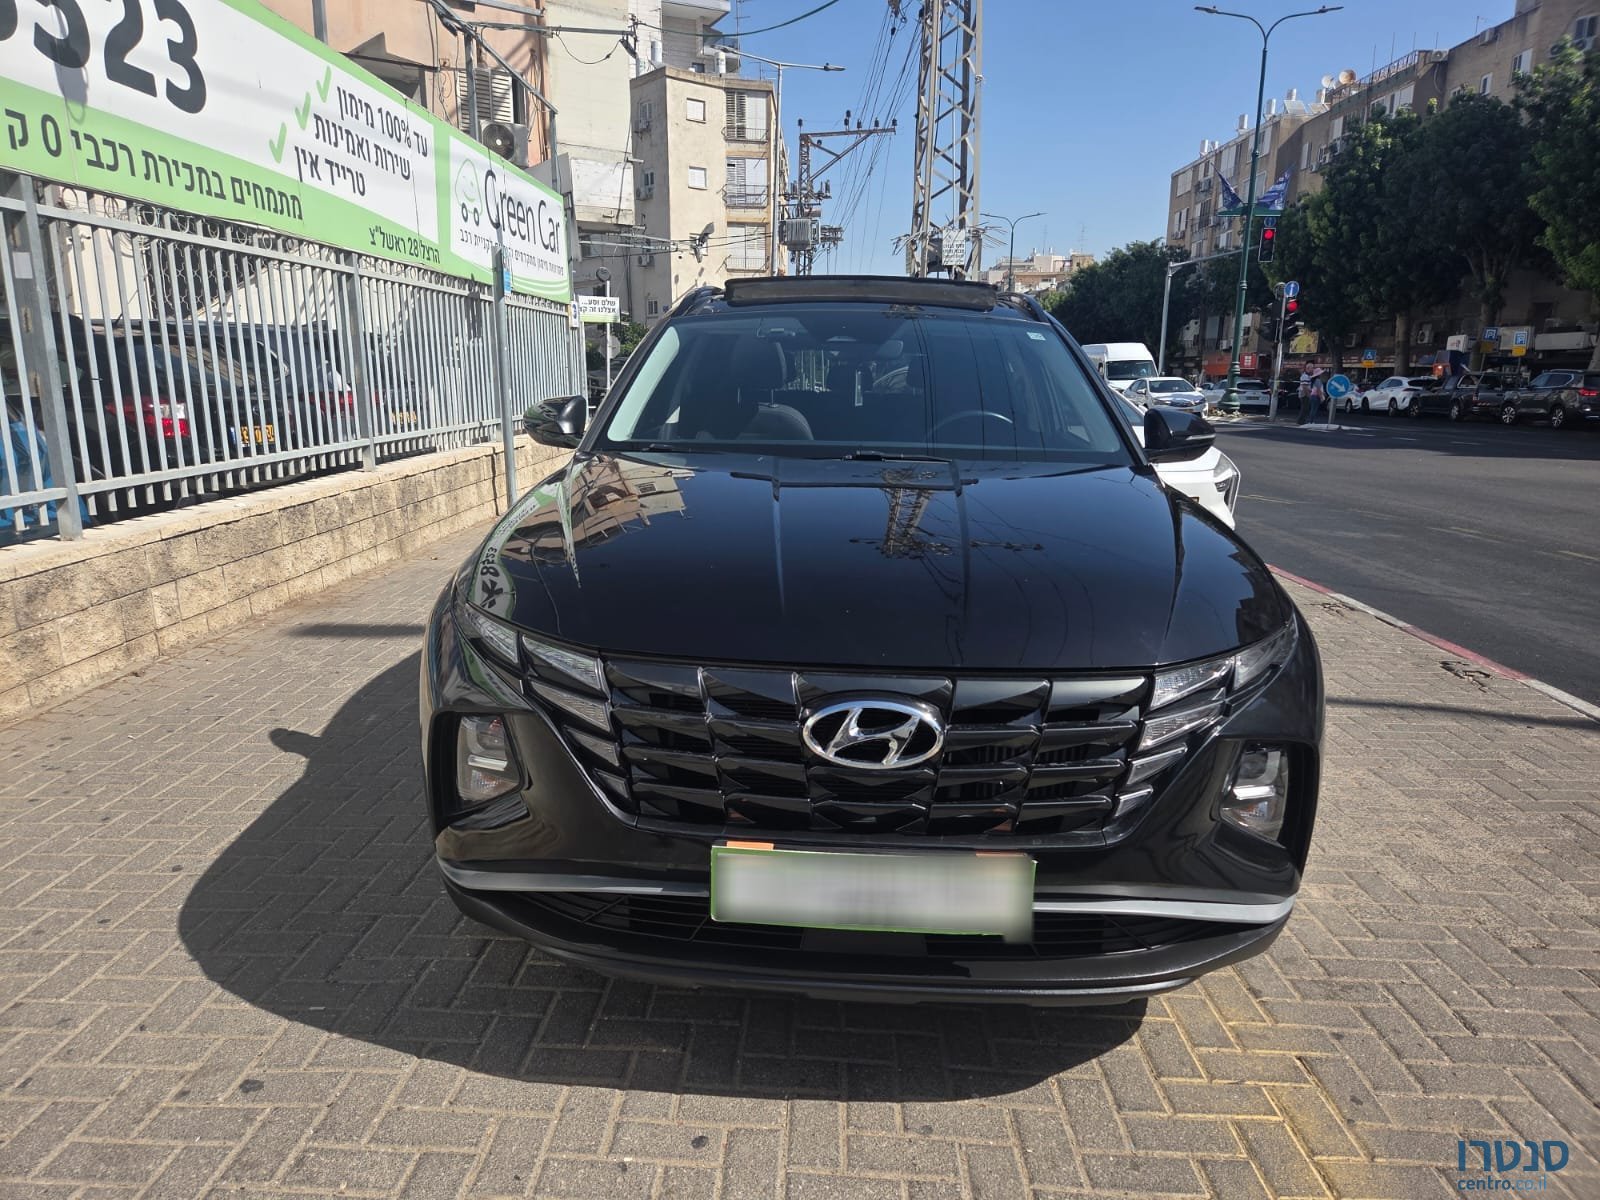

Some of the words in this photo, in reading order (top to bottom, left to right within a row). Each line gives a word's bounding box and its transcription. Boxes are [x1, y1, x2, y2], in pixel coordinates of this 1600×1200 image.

[0, 0, 206, 114] 523
[337, 86, 375, 129] מימון
[377, 107, 412, 149] 100%
[40, 114, 62, 158] 0
[70, 129, 137, 178] רכבי
[313, 113, 371, 163] ואמינות
[413, 131, 428, 157] עד
[142, 150, 227, 201] במכירת
[294, 146, 322, 183] אין
[325, 158, 366, 197] טרייד
[374, 143, 411, 180] שירות
[230, 176, 304, 221] מתמחים
[484, 169, 536, 245] Green
[538, 200, 561, 255] Car
[407, 237, 419, 258] 28
[420, 240, 440, 264] הרצל
[459, 228, 473, 247] רכב
